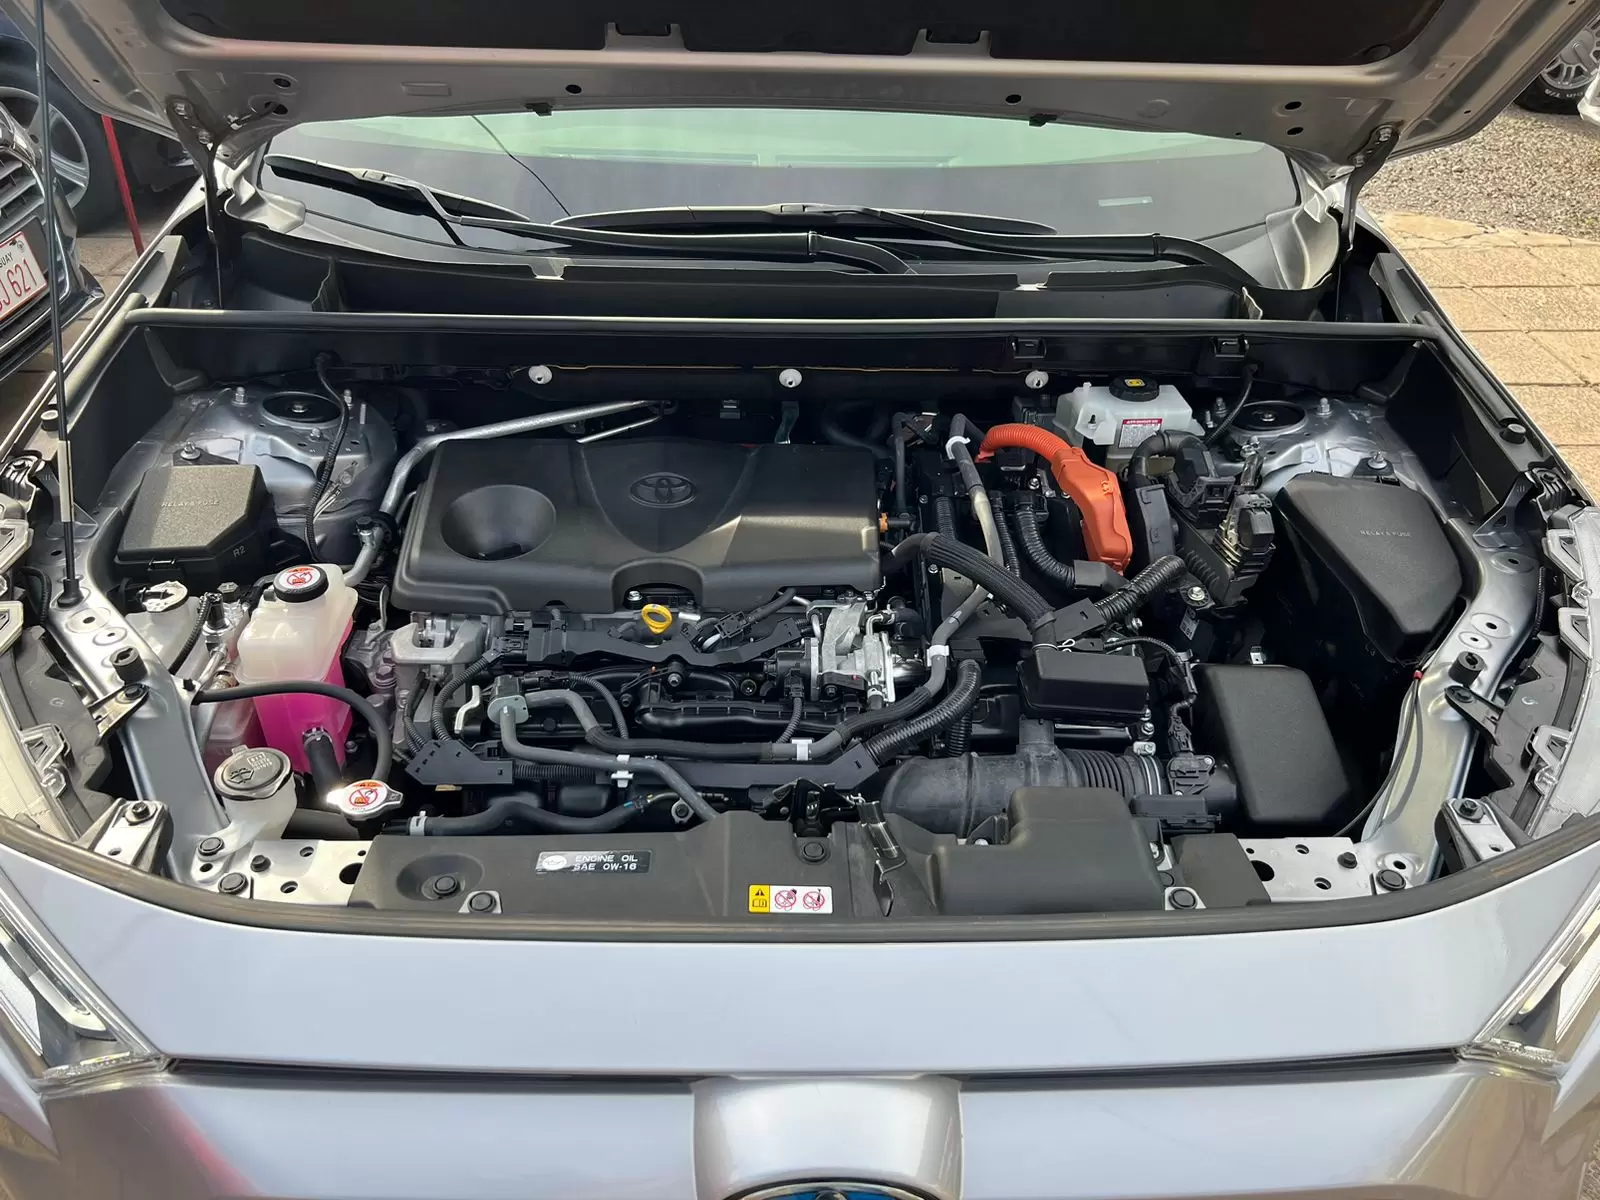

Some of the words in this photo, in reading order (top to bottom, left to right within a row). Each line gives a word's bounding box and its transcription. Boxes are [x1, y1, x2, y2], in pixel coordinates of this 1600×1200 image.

[575, 854, 615, 862] ENGINE
[621, 854, 638, 862] OIL
[572, 863, 596, 872] SAE
[602, 863, 637, 871] 0W-16
